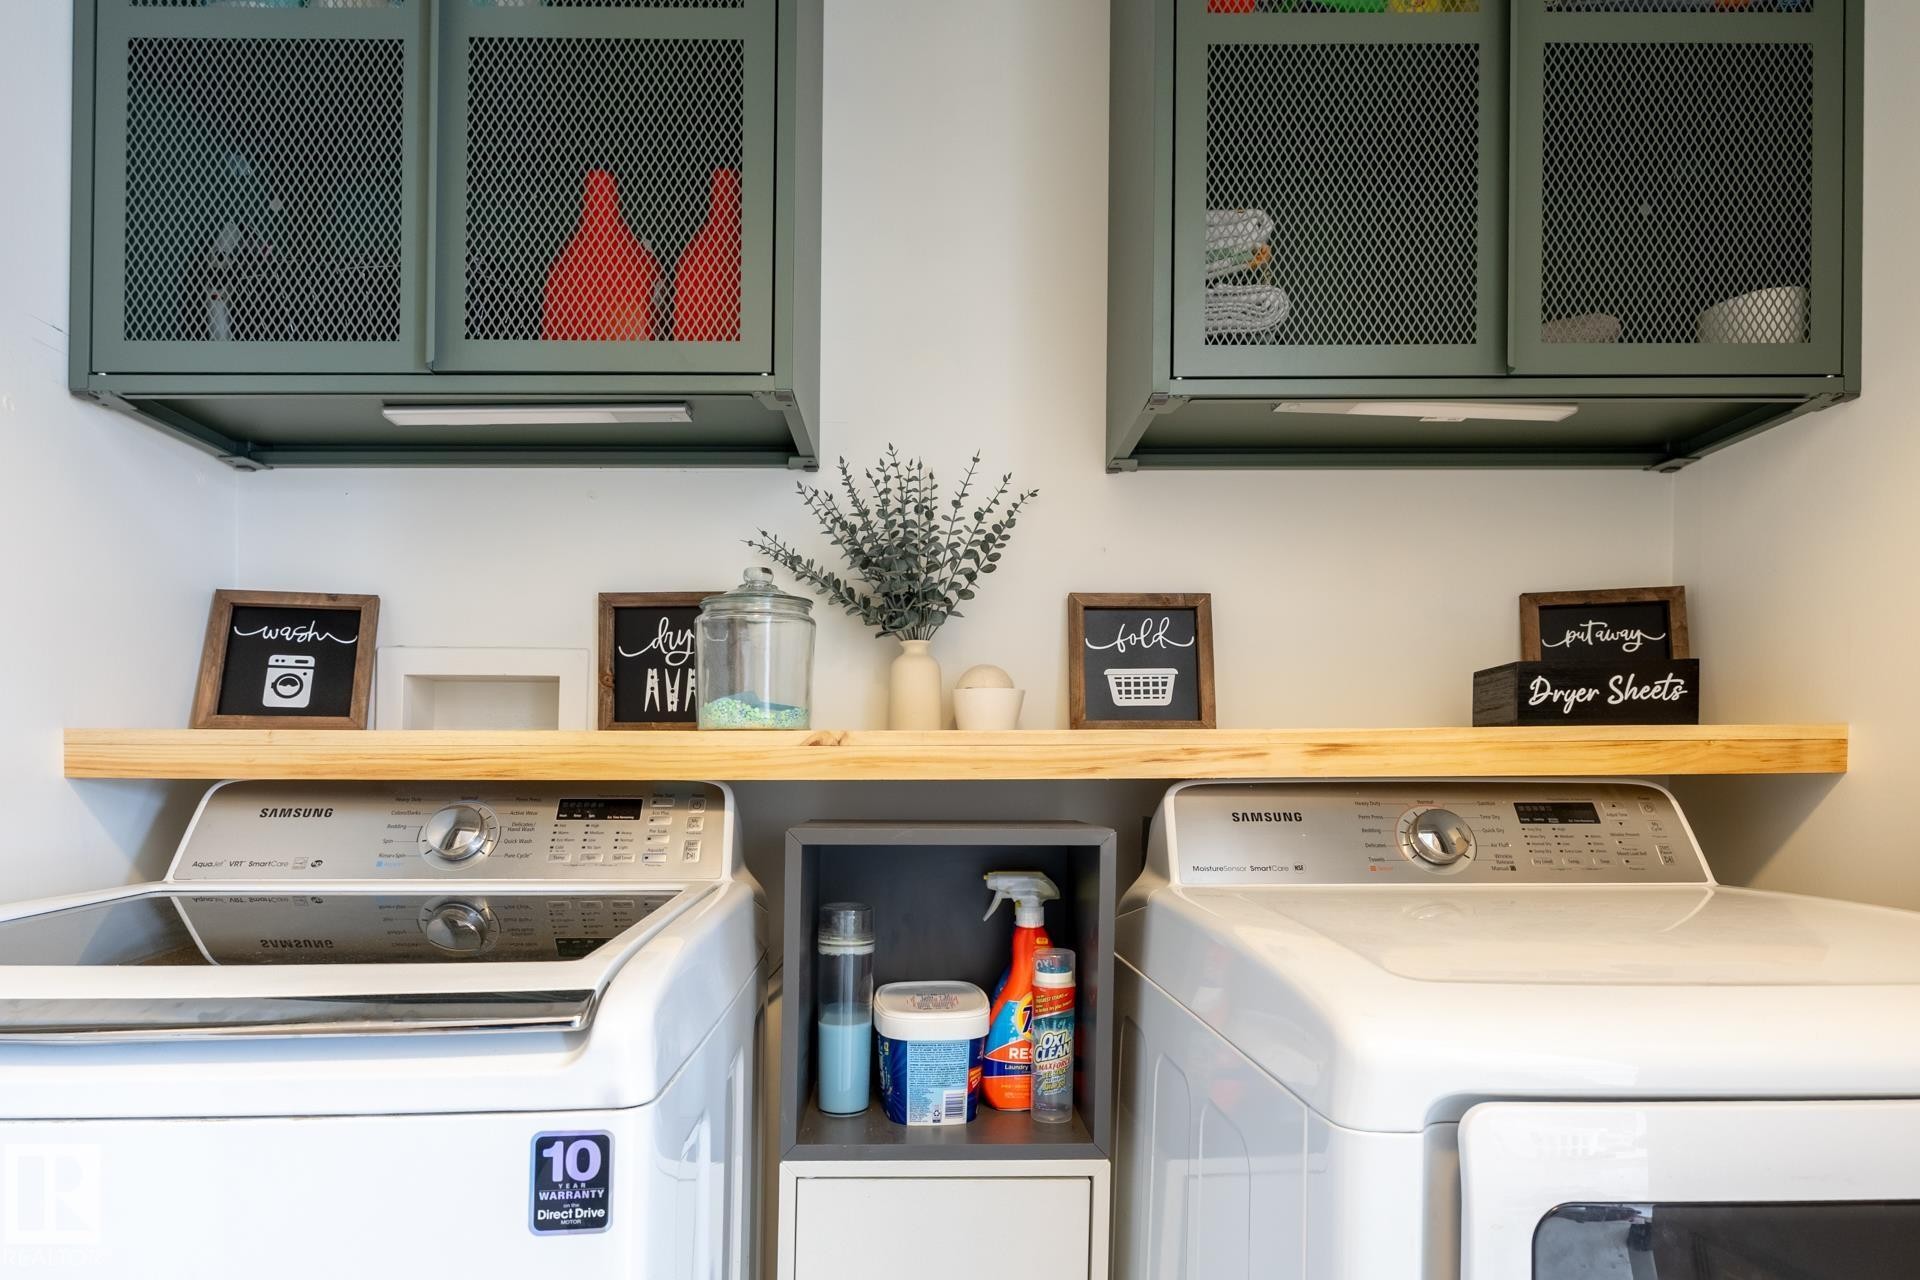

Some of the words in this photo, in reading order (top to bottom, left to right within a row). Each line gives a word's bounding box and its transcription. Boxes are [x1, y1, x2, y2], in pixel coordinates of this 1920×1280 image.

[234, 620, 358, 644] wash
[618, 616, 696, 666] dry
[1085, 616, 1194, 653] fold
[1528, 675, 1600, 714] Dryer
[1608, 673, 1688, 704] Sheets
[259, 808, 334, 818] SAMSUNG
[1232, 812, 1302, 822] SAMSUNG
[1035, 1042, 1072, 1062] CLEAN
[542, 1139, 602, 1182] 10
[538, 1189, 604, 1200] WARRANTY
[538, 1208, 573, 1220] Direct
[575, 1207, 606, 1218] Drive
